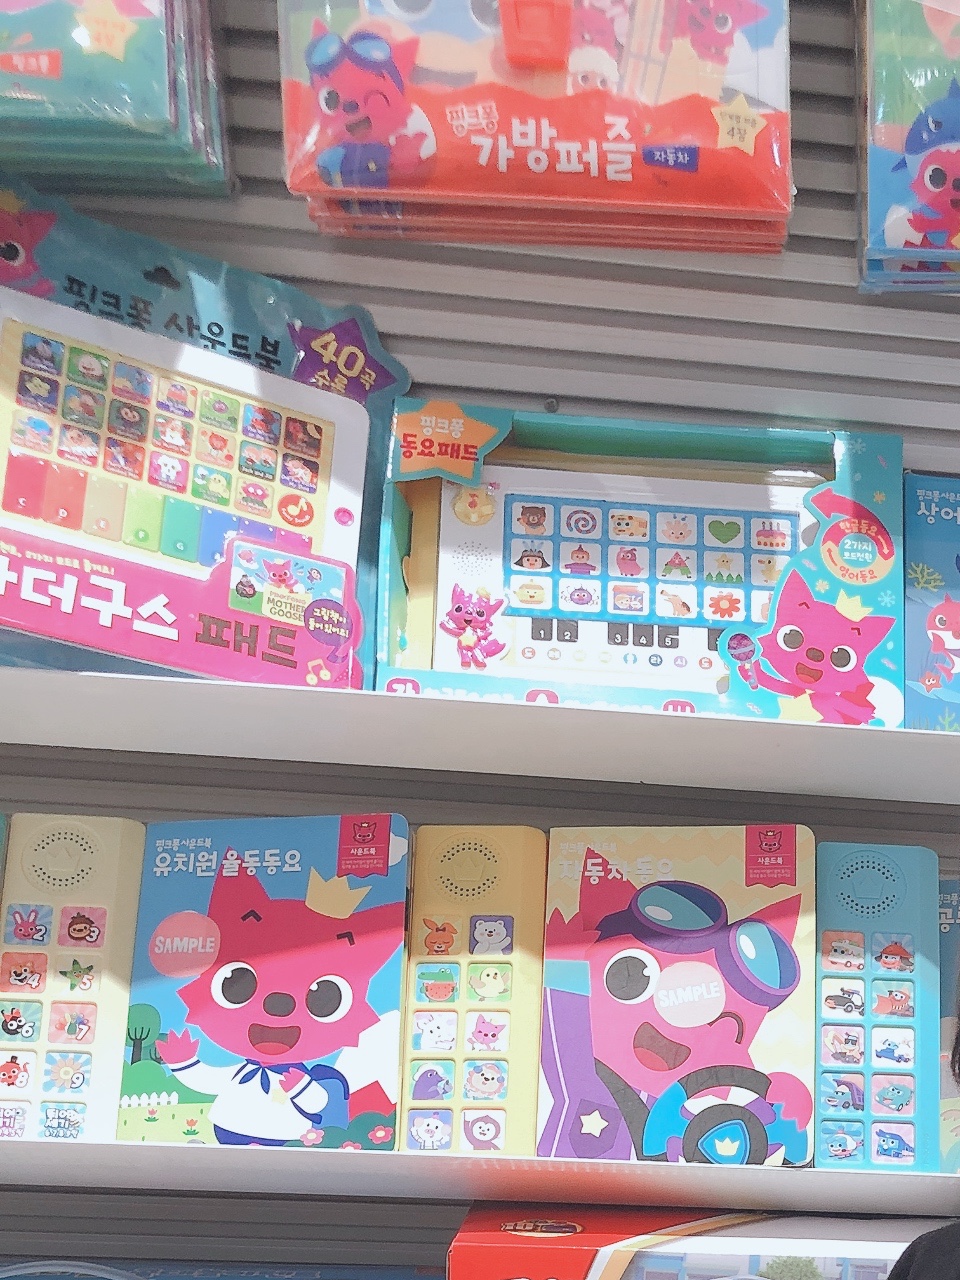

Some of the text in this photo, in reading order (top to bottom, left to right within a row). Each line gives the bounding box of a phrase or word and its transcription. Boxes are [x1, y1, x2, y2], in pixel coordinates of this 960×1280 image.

[446, 100, 500, 137] 핑크퐁
[470, 115, 637, 182] 가방퍼즐
[654, 151, 691, 166] 자동차
[419, 414, 465, 438] 핑크퐁
[400, 432, 479, 463] 동요패드
[916, 489, 940, 503] 핑크퐁
[838, 519, 878, 537] 한글동요
[843, 540, 872, 551] 2가지
[839, 565, 878, 584] 영어동요
[313, 606, 347, 625] 그림책이
[195, 612, 298, 669] 패드
[155, 838, 181, 852] 핑크퐁
[350, 847, 377, 856] 사운드북
[153, 849, 302, 877] 유치원 율동동요
[757, 856, 784, 865] 사운드북
[32, 924, 100, 943] 2 3
[153, 934, 216, 955] SAMPLE
[28, 974, 93, 990] 4 5
[658, 981, 721, 1008] SAMPLE
[20, 1022, 90, 1040] 6 7
[70, 1072, 85, 1089] 9
